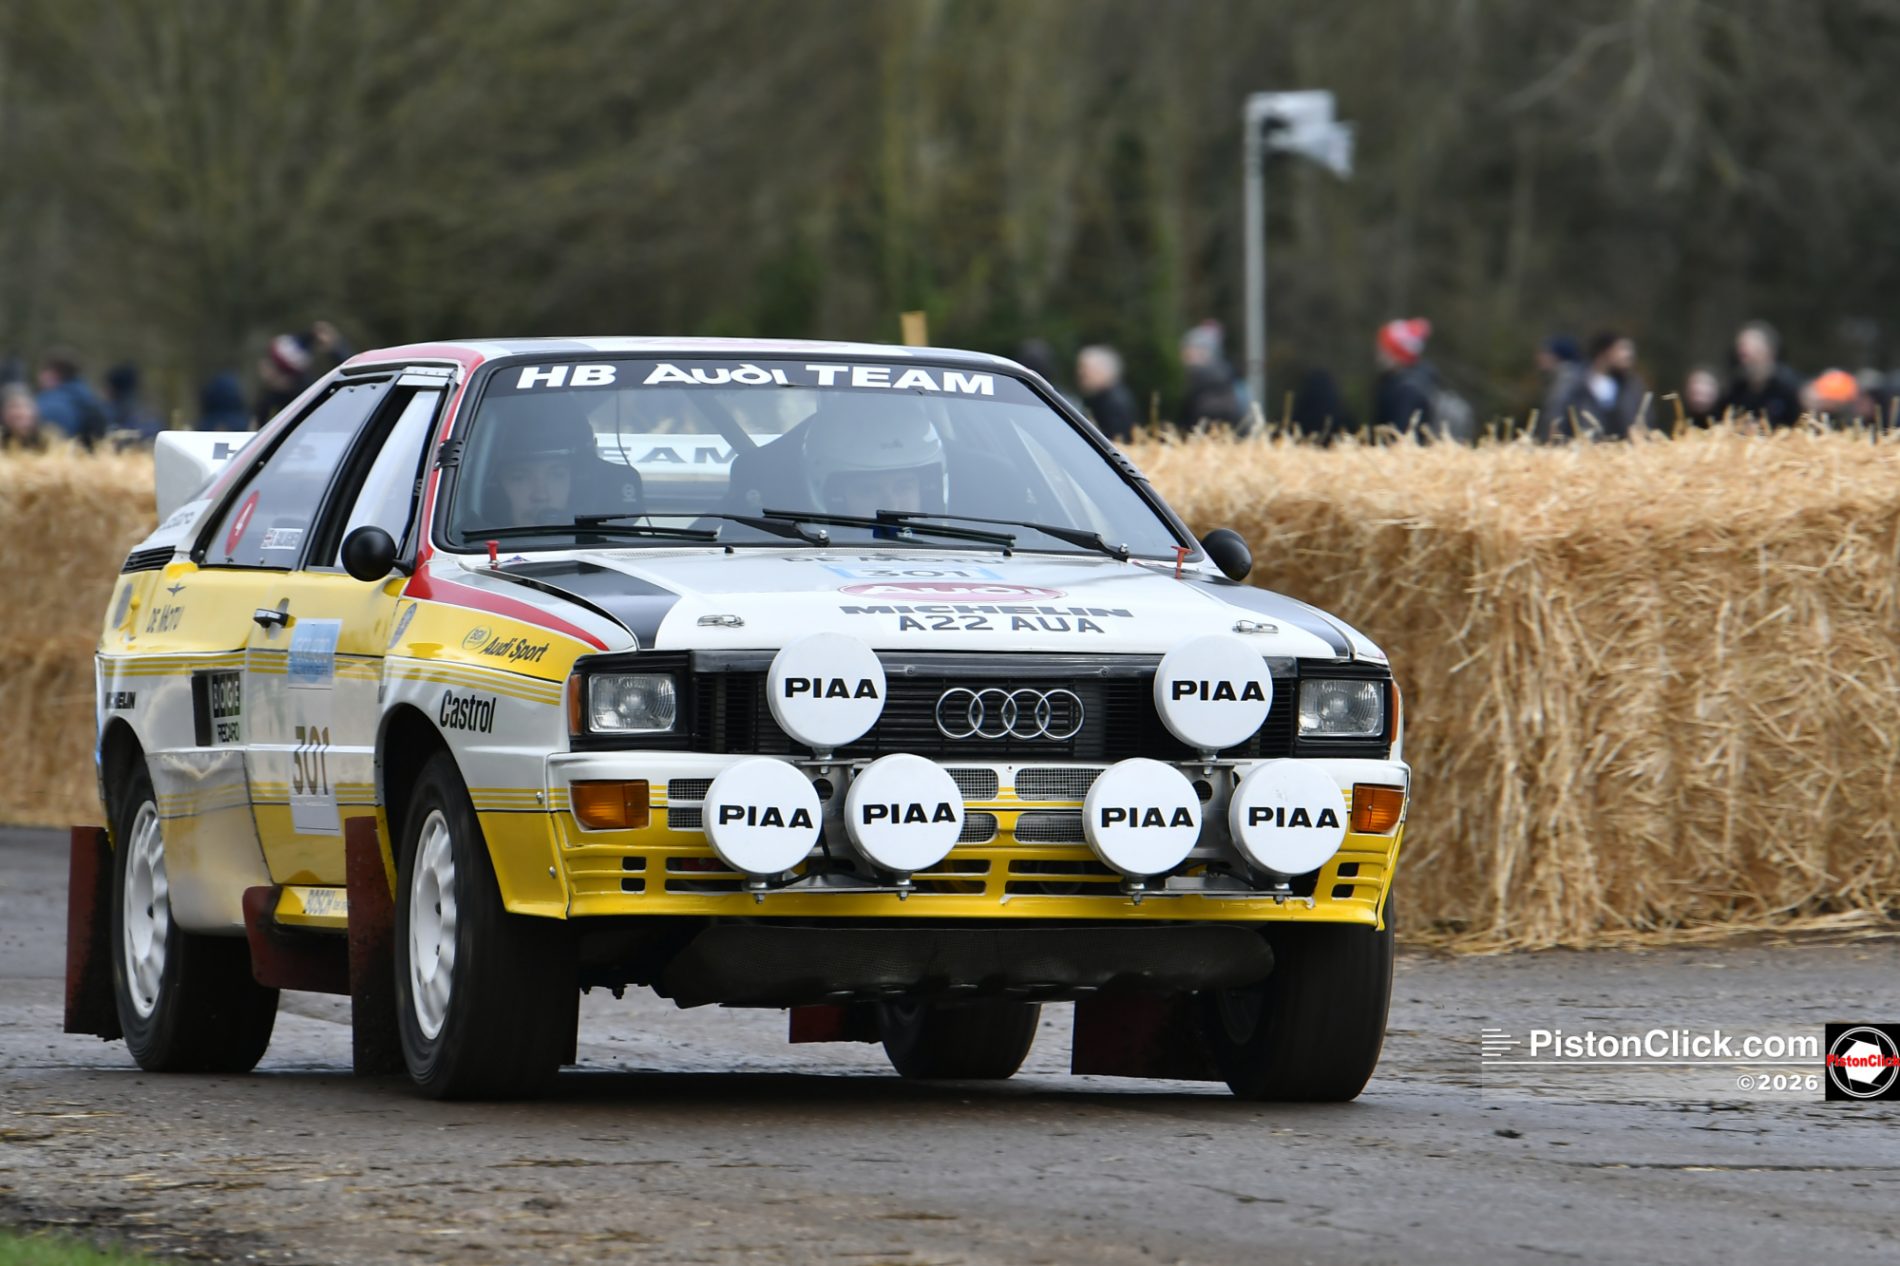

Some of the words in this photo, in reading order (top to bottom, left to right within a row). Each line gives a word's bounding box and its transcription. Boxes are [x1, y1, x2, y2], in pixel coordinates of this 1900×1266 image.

[516, 364, 617, 389] HB
[805, 364, 995, 395] TEAM
[594, 446, 738, 463] EAM
[860, 569, 972, 578] 301
[839, 605, 1134, 617] MICHELIN
[900, 616, 994, 632] A22
[1011, 616, 1105, 634] AUA
[480, 637, 517, 655] Audi
[510, 638, 550, 663] Sport
[784, 676, 879, 700] PIAA
[1171, 679, 1266, 702] PIAA
[439, 689, 497, 734] Castrol
[217, 721, 240, 743] RECARO
[293, 725, 330, 796] 301
[719, 804, 814, 830] PIAA
[862, 801, 956, 825] PIAA
[1101, 806, 1195, 828] PIAA
[1247, 806, 1340, 829] PIAA
